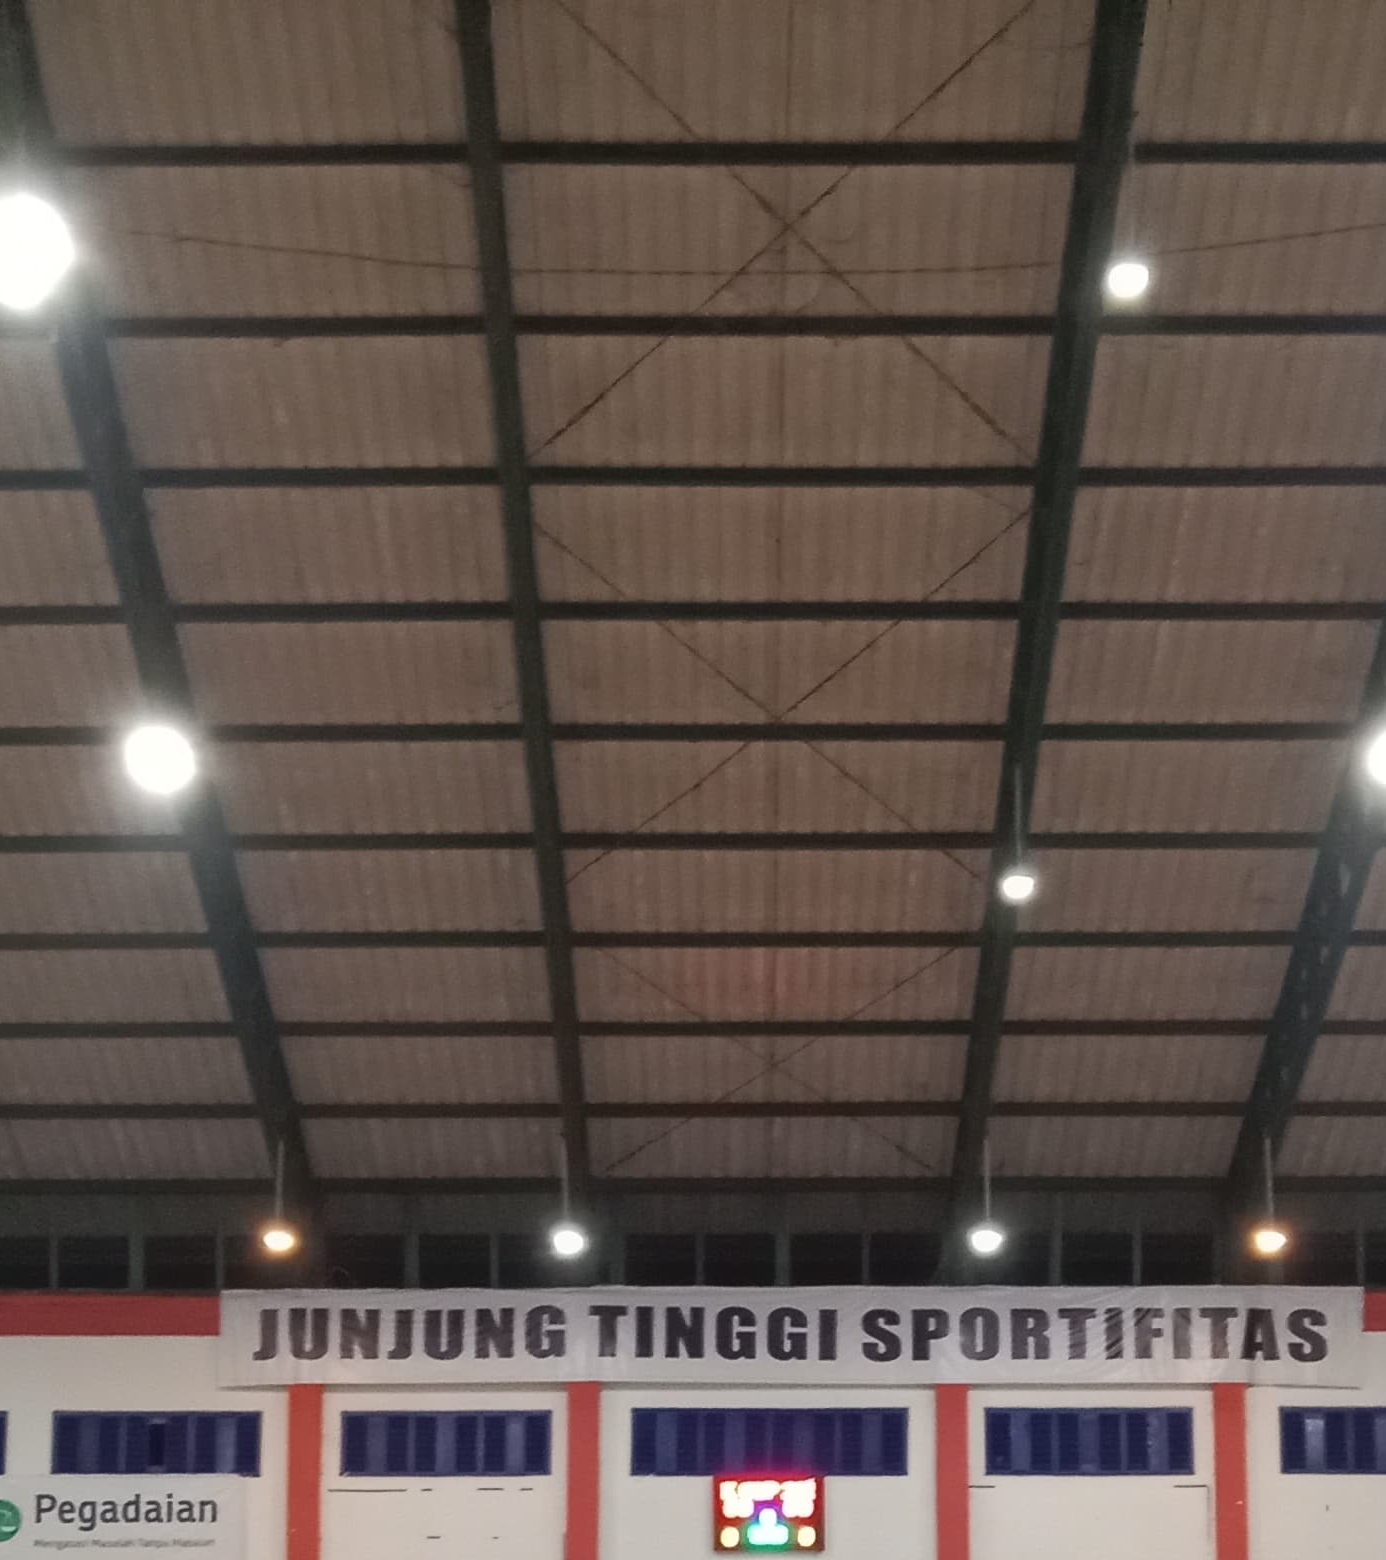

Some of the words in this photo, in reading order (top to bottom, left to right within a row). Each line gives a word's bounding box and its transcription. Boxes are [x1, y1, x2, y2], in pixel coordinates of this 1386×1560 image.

[253, 1305, 566, 1361] JUNJUNG
[589, 1304, 838, 1361] TINGGI
[861, 1306, 1328, 1362] SPORTIFITAS
[35, 1493, 218, 1532] Pegadaian
